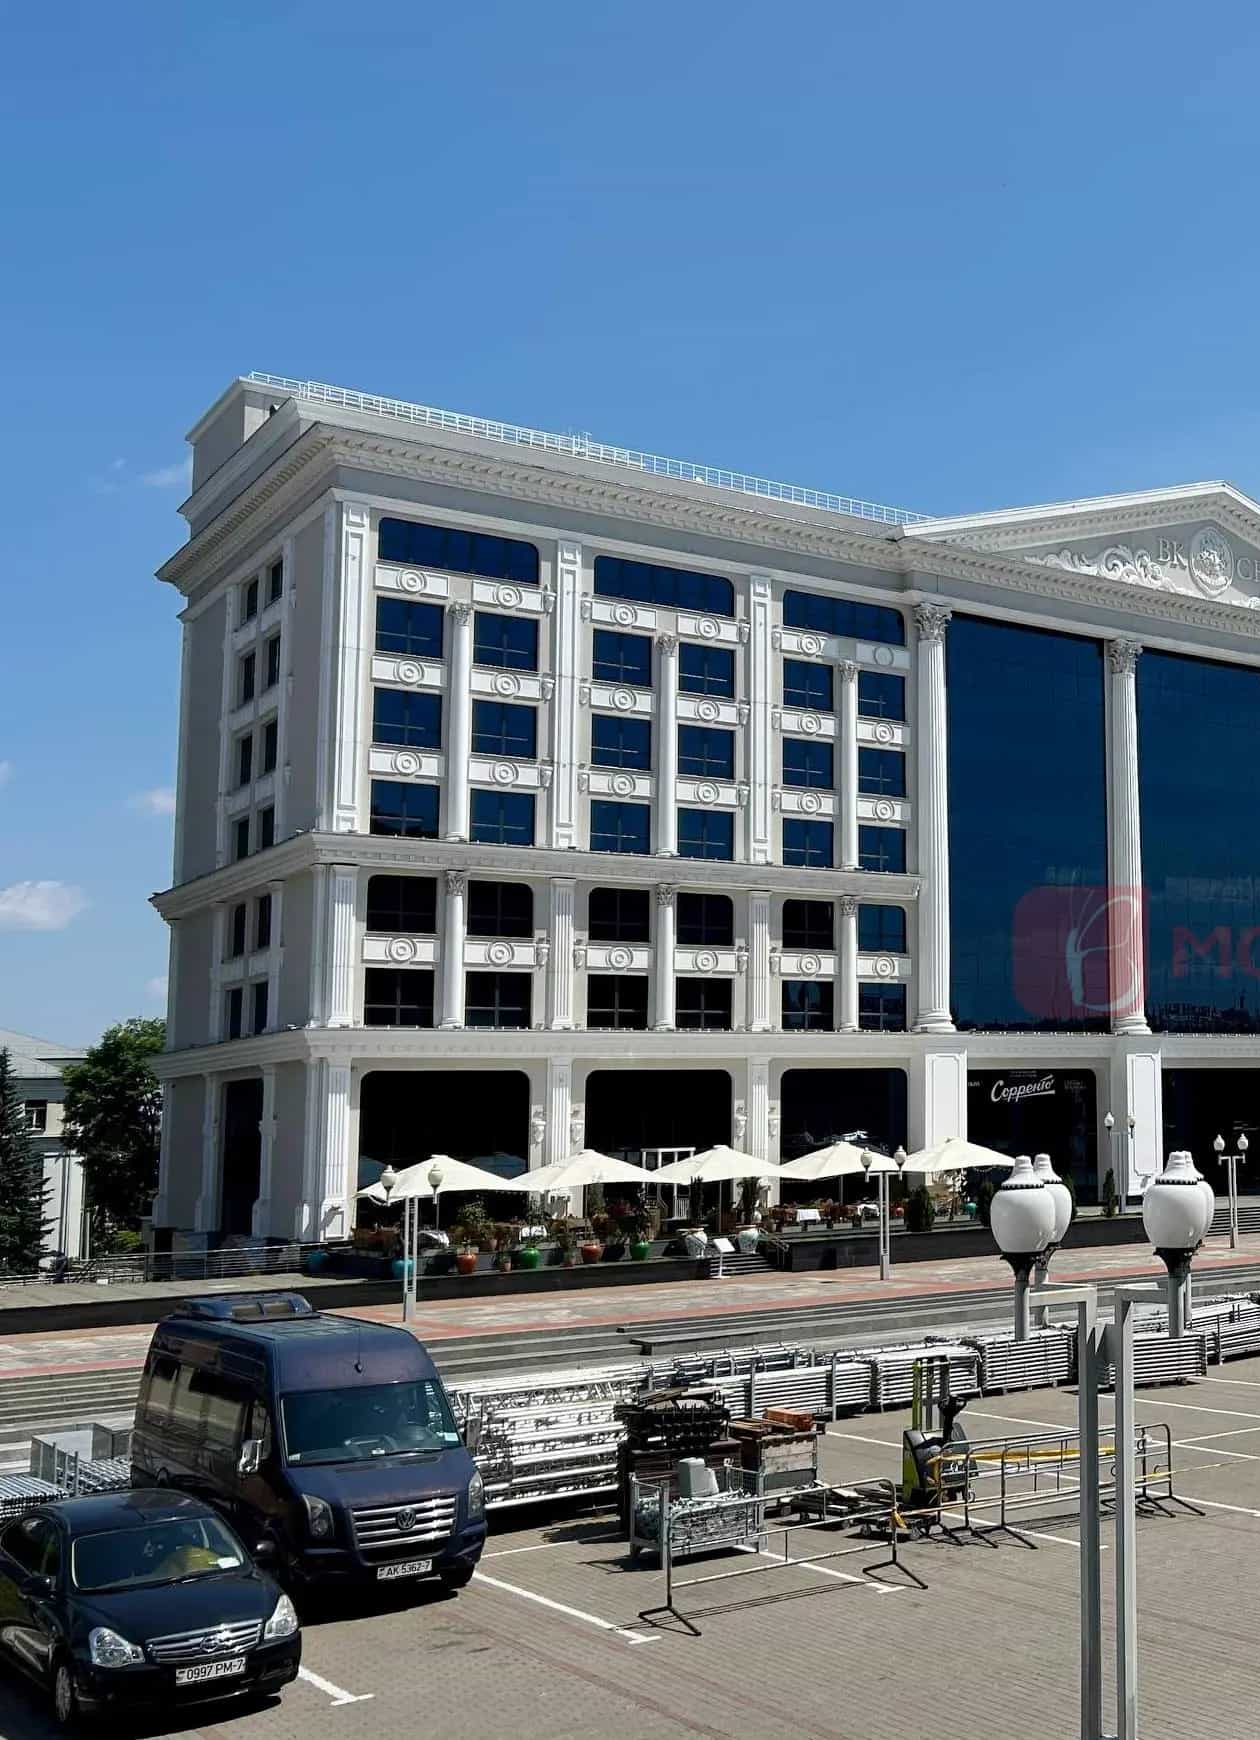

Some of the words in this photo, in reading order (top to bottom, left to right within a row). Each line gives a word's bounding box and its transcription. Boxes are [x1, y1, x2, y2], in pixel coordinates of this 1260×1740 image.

[991, 1074, 1055, 1102] Сорренто
[186, 1665, 213, 1681] 0997
[215, 1659, 244, 1675] PM-7
